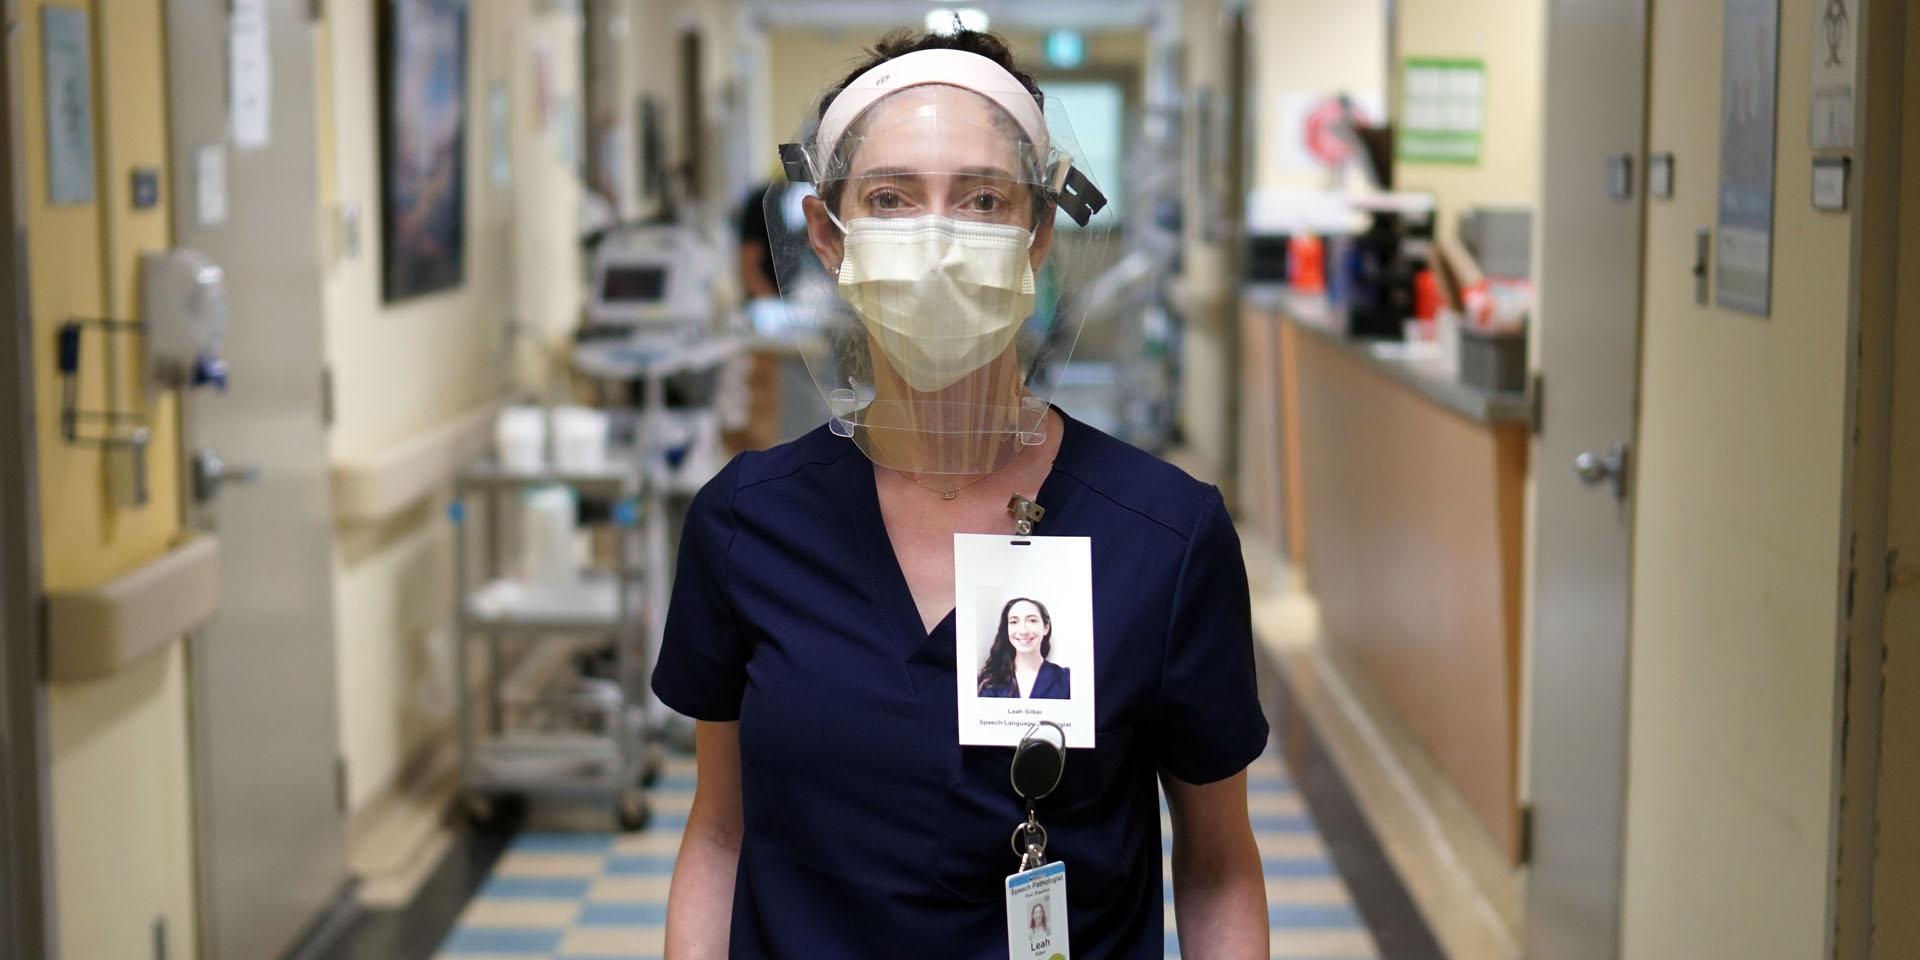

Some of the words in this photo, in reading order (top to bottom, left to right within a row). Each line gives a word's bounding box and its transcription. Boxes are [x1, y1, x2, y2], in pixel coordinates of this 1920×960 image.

[1010, 885, 1031, 896] Speech
[1032, 874, 1064, 888] Pathologist
[1030, 938, 1050, 951] Leah
